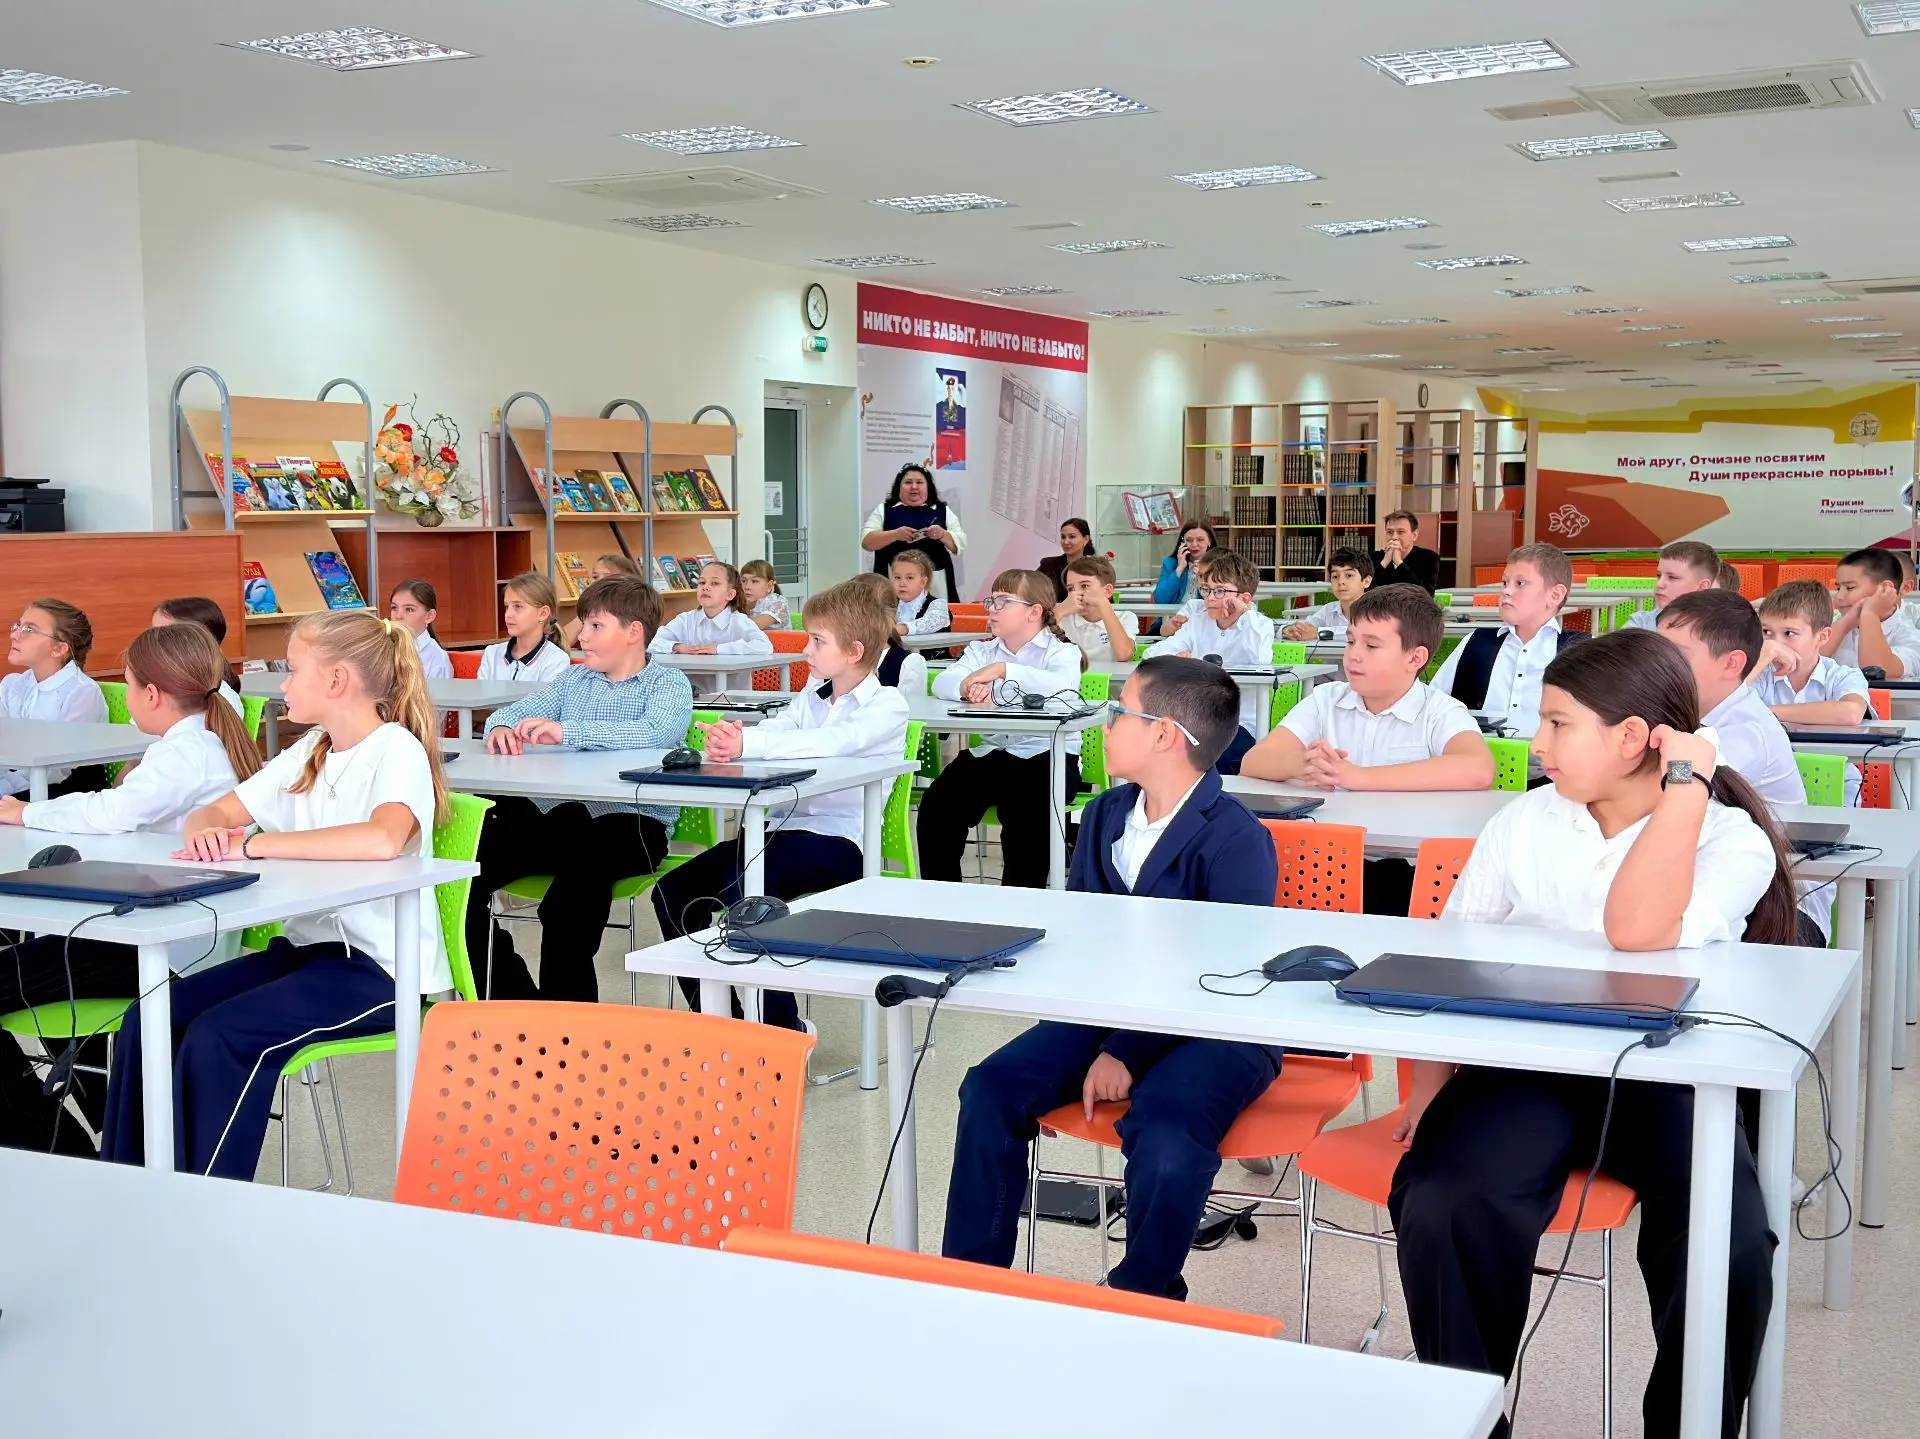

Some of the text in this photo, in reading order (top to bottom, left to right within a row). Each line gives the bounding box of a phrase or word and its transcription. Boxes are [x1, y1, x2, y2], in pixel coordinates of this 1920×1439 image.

[863, 310, 1085, 360] НИКТО НЕ ЗАБЫТ, НИЧТО НЕ ЗАБЫТО!
[1617, 454, 1825, 468] Мой друг, Отчизне посвятим
[1689, 465, 1894, 482] Души прекрасные порывы!
[1821, 499, 1864, 508] Пушкин
